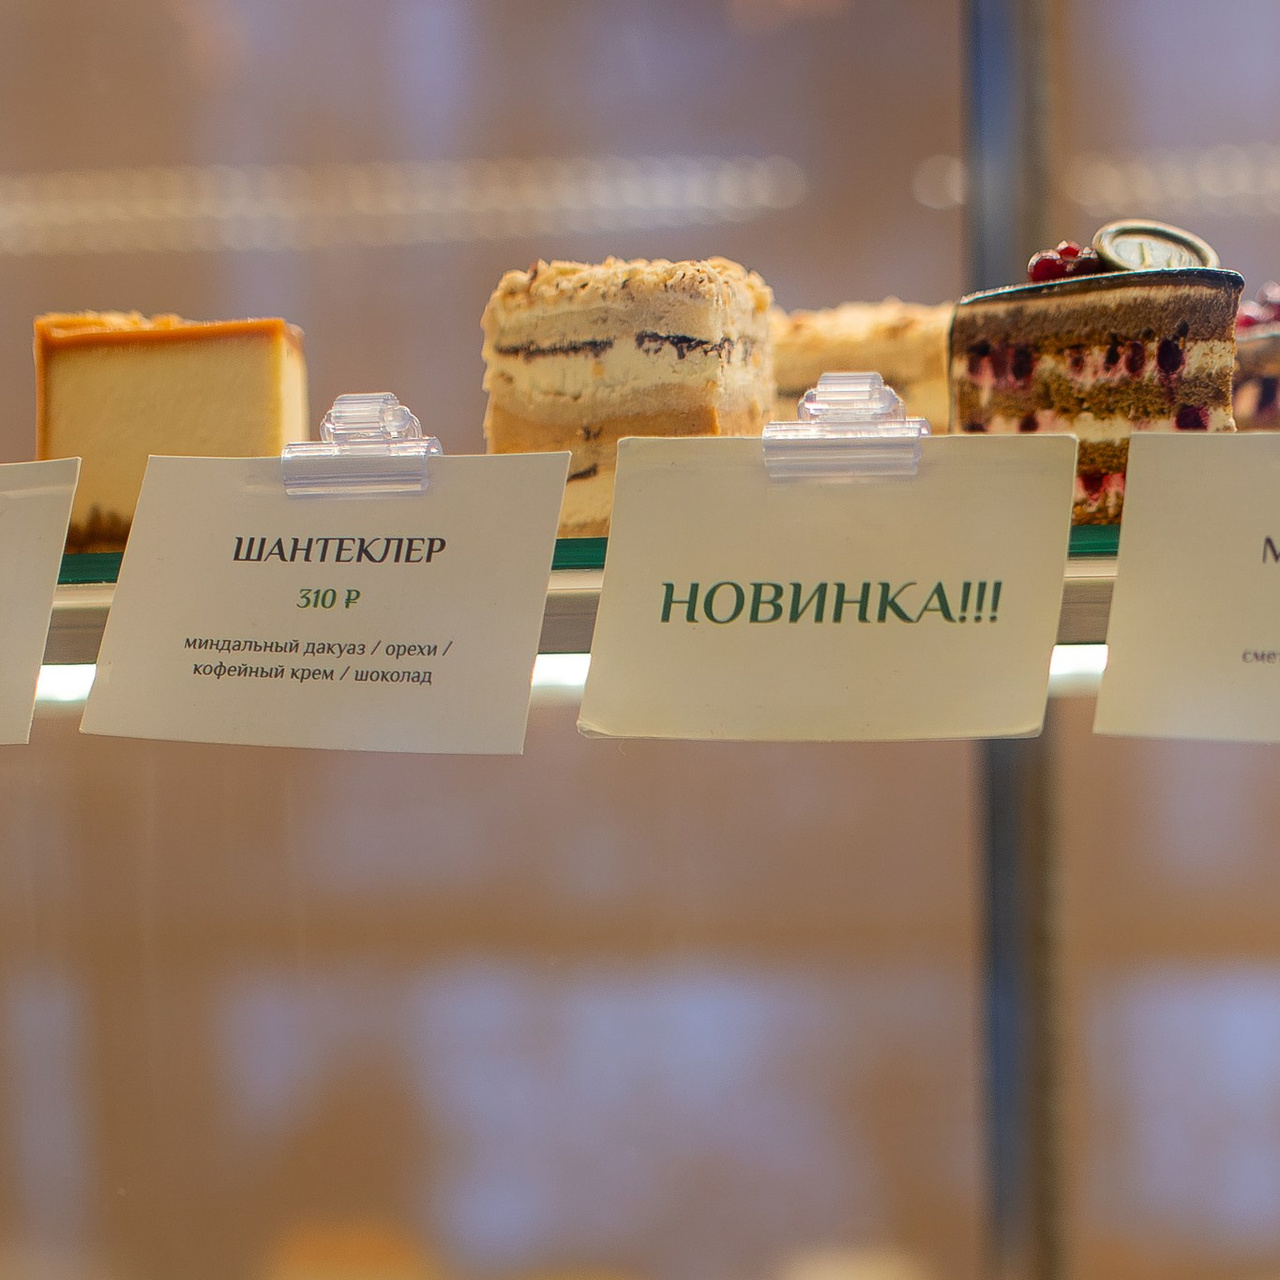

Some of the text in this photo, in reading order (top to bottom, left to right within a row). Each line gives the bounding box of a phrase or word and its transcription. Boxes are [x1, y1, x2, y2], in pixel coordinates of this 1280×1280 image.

[233, 537, 446, 563] ШАНТЕКЛЕР
[297, 589, 336, 609] 310
[661, 580, 1002, 626] НОВИНКА!!!
[184, 636, 299, 654] миндальный
[304, 641, 366, 659] дакуаз
[386, 642, 438, 660] орехи
[193, 661, 284, 680] кофейный
[290, 667, 334, 683] крем
[355, 668, 432, 686] шоколад
